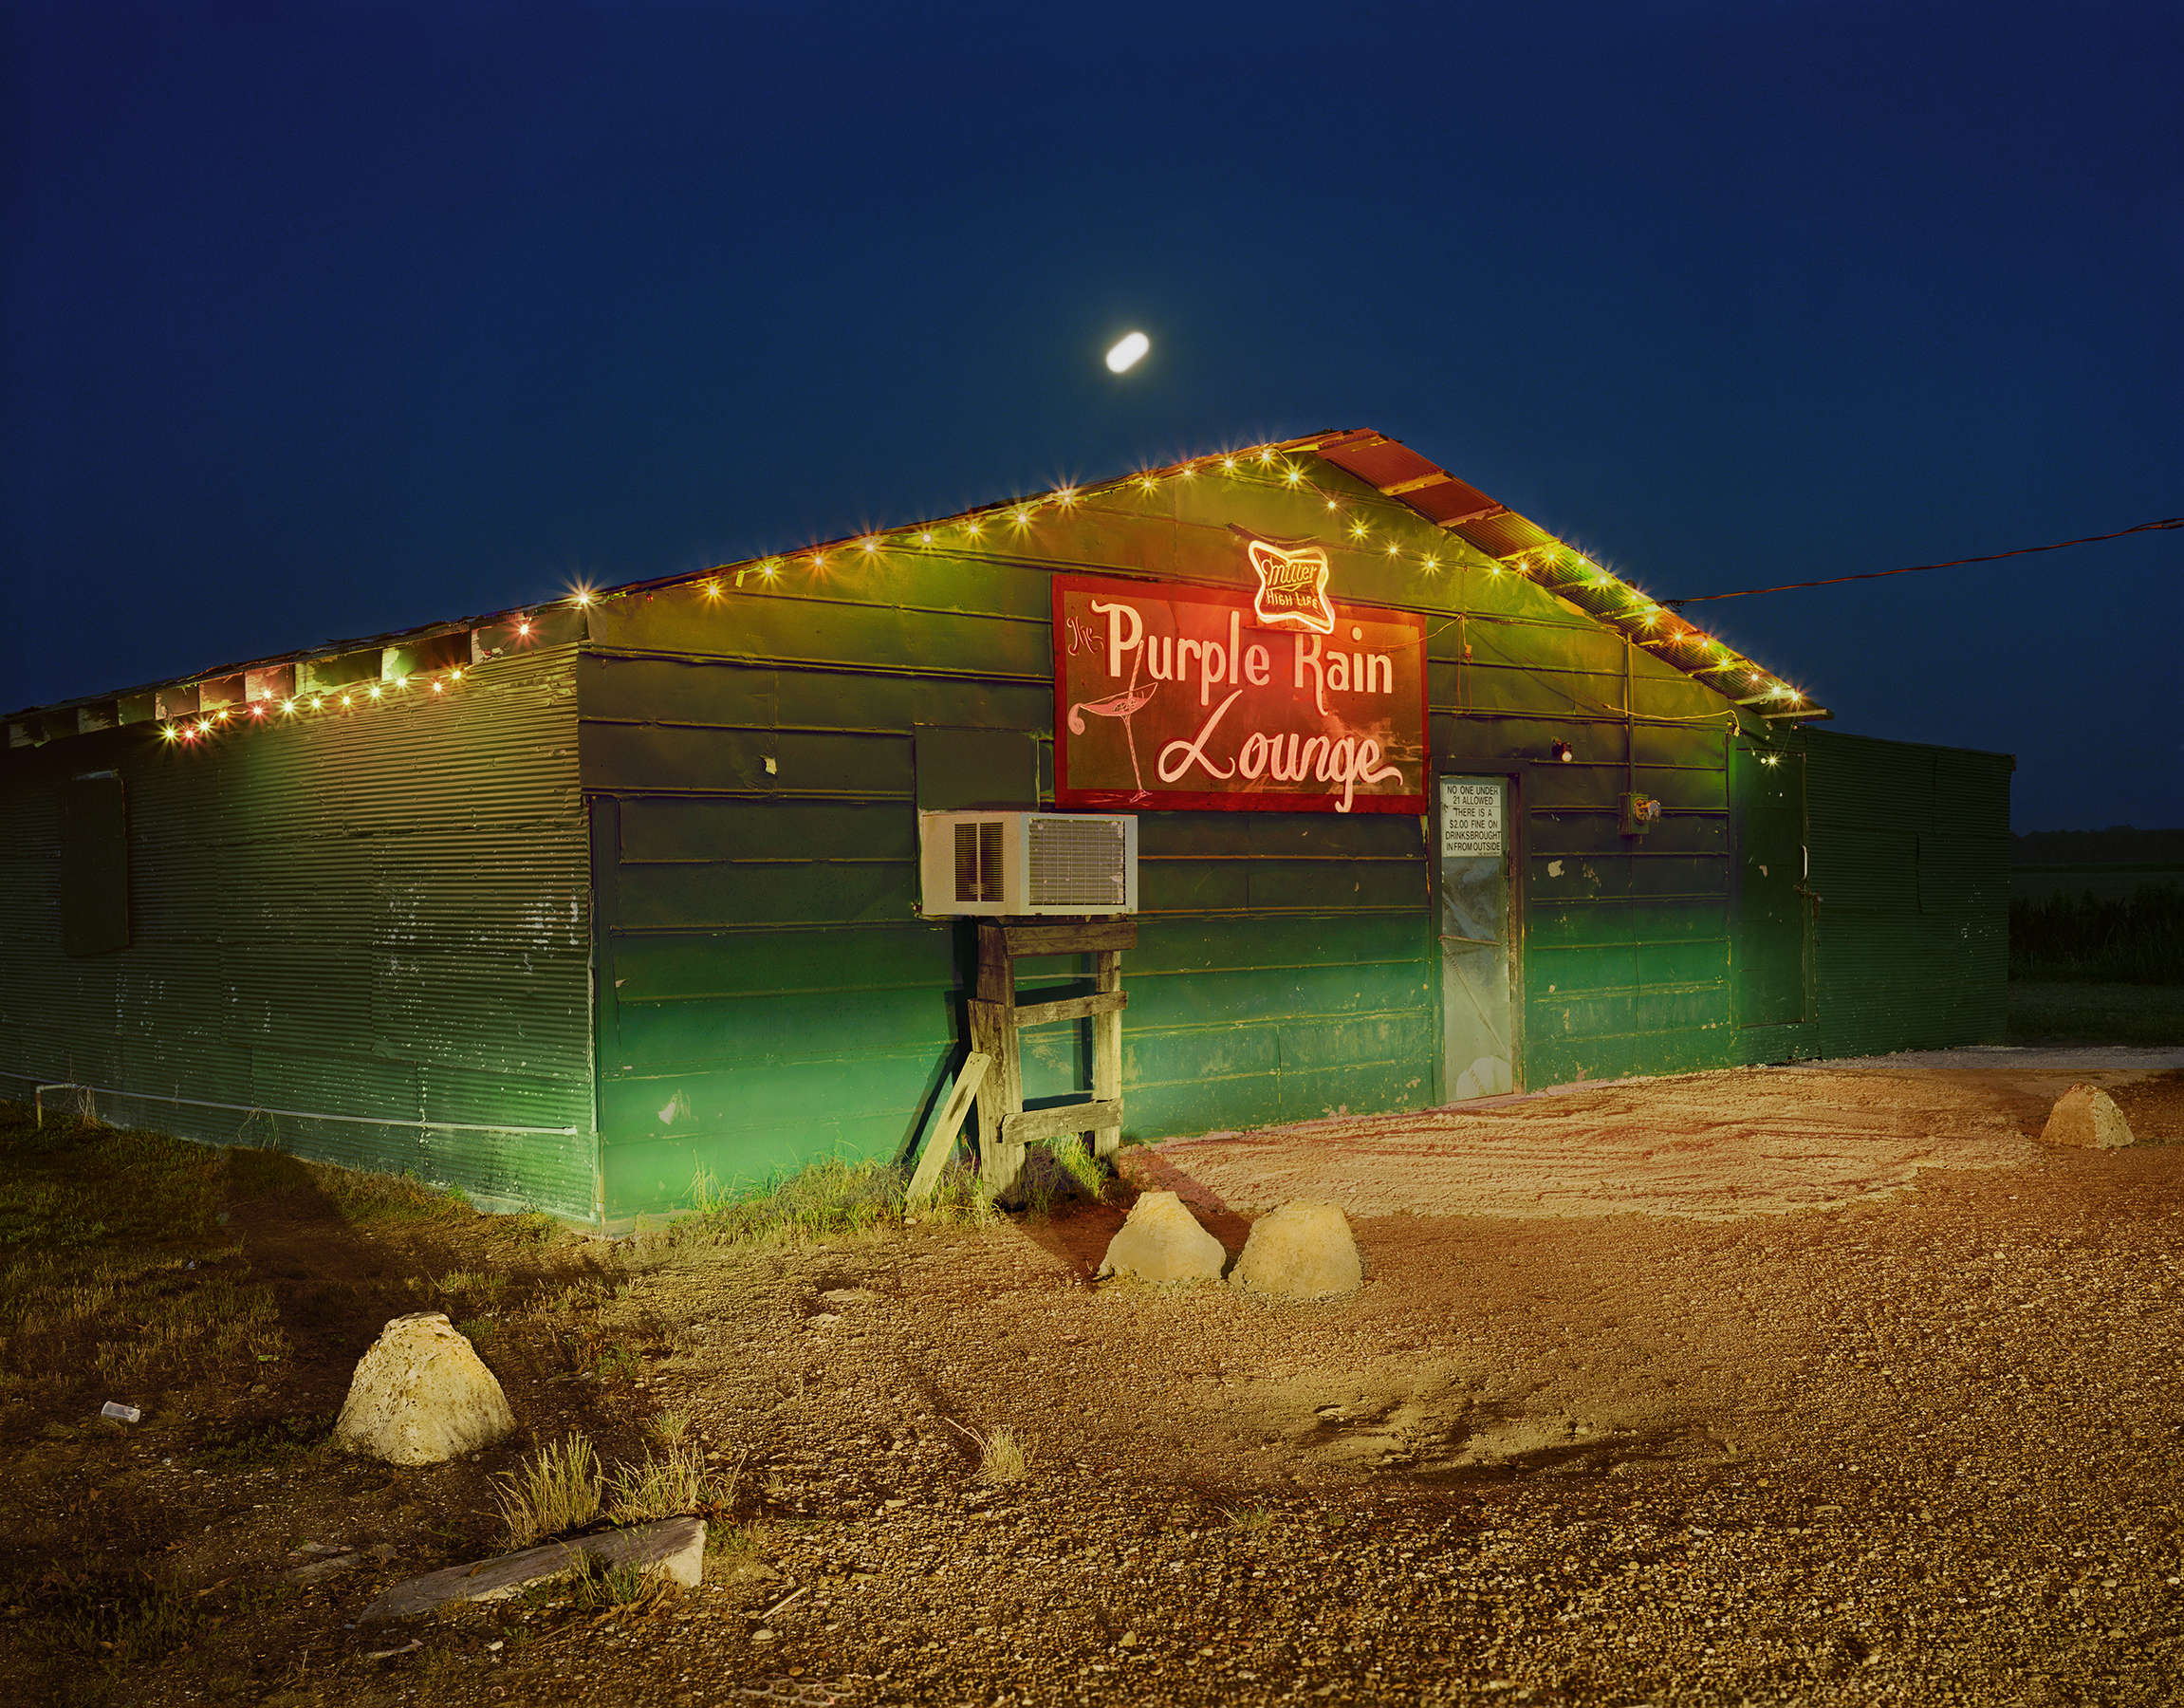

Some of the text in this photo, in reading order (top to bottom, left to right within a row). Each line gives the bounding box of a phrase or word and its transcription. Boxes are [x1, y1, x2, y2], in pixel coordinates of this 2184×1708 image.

[1262, 559, 1317, 585] Miller
[1066, 600, 1393, 716] The Purple Rain
[1157, 689, 1403, 813] Lounge
[1447, 785, 1499, 795] NO ONE UNDER
[1453, 795, 1494, 806] 21 ALLOWED
[1453, 808, 1492, 818] THERE IS A
[1471, 820, 1486, 829] FINE
[1488, 820, 1498, 829] ON
[1446, 842, 1501, 851] IN FROM OUTSIDE
